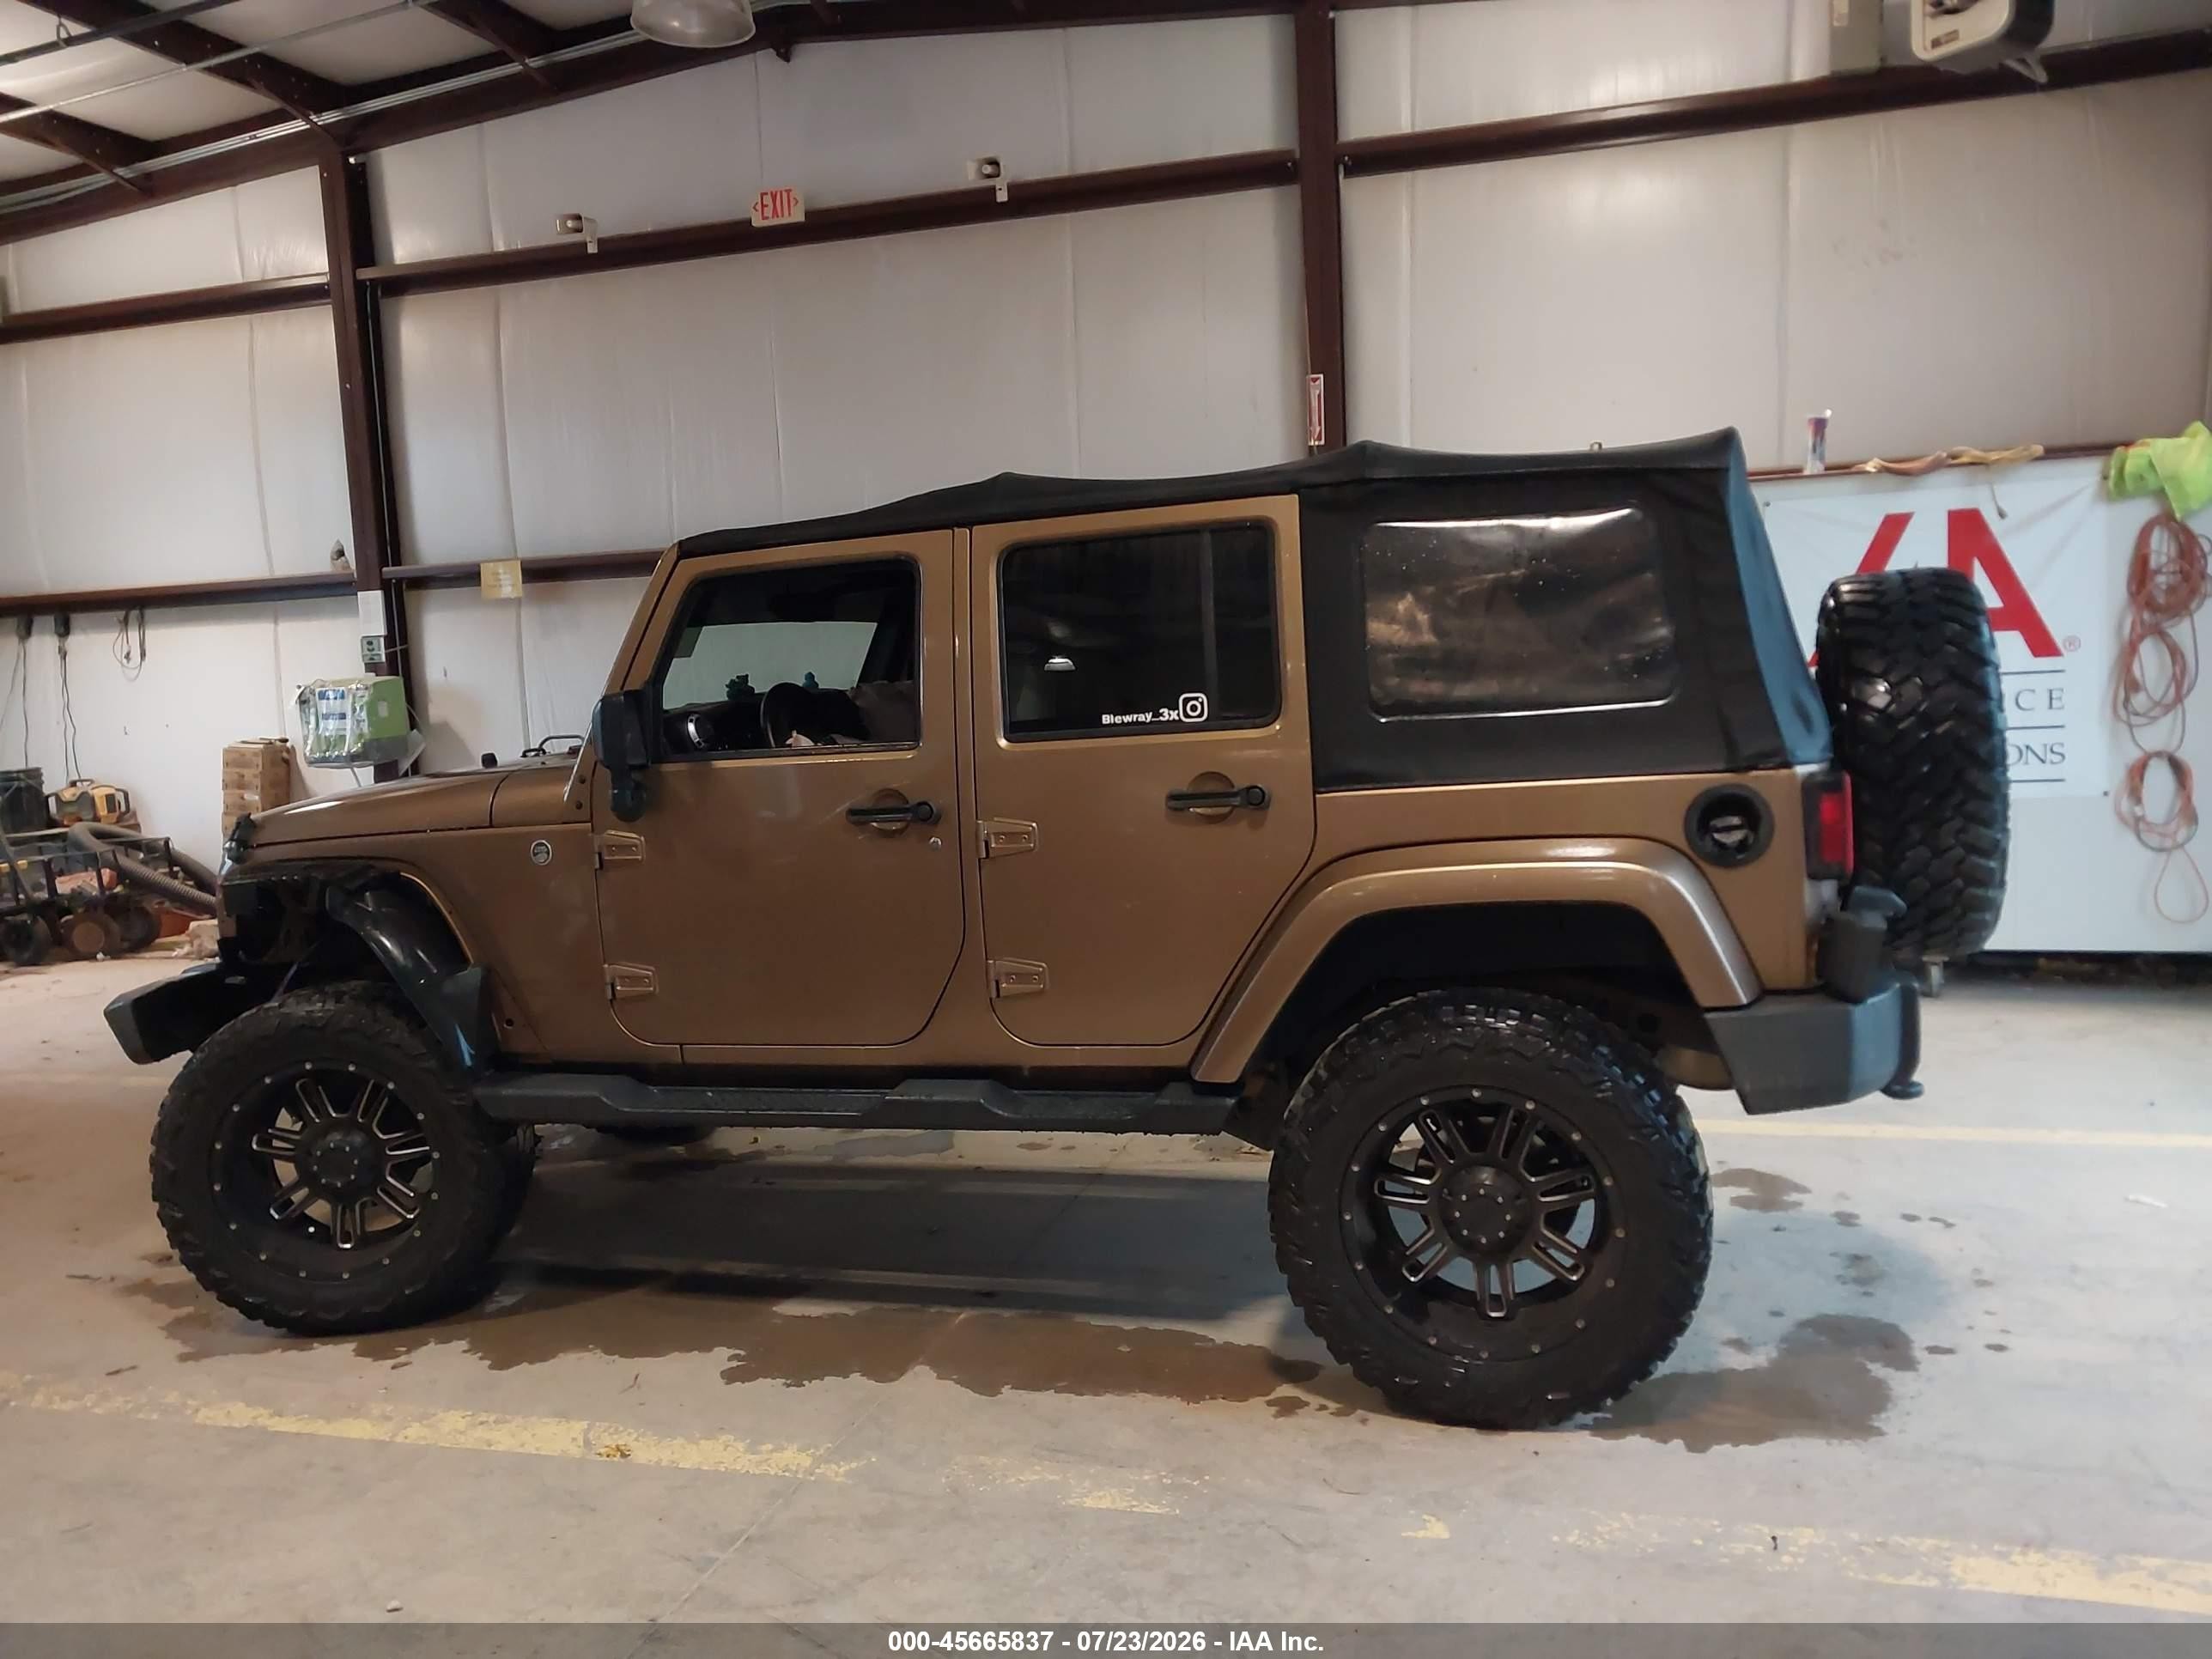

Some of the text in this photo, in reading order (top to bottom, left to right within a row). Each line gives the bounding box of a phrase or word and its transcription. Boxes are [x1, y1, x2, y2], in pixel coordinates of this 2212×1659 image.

[760, 189, 792, 220] EXIT
[2014, 689, 2064, 711] CE
[2007, 742, 2066, 766] ONS
